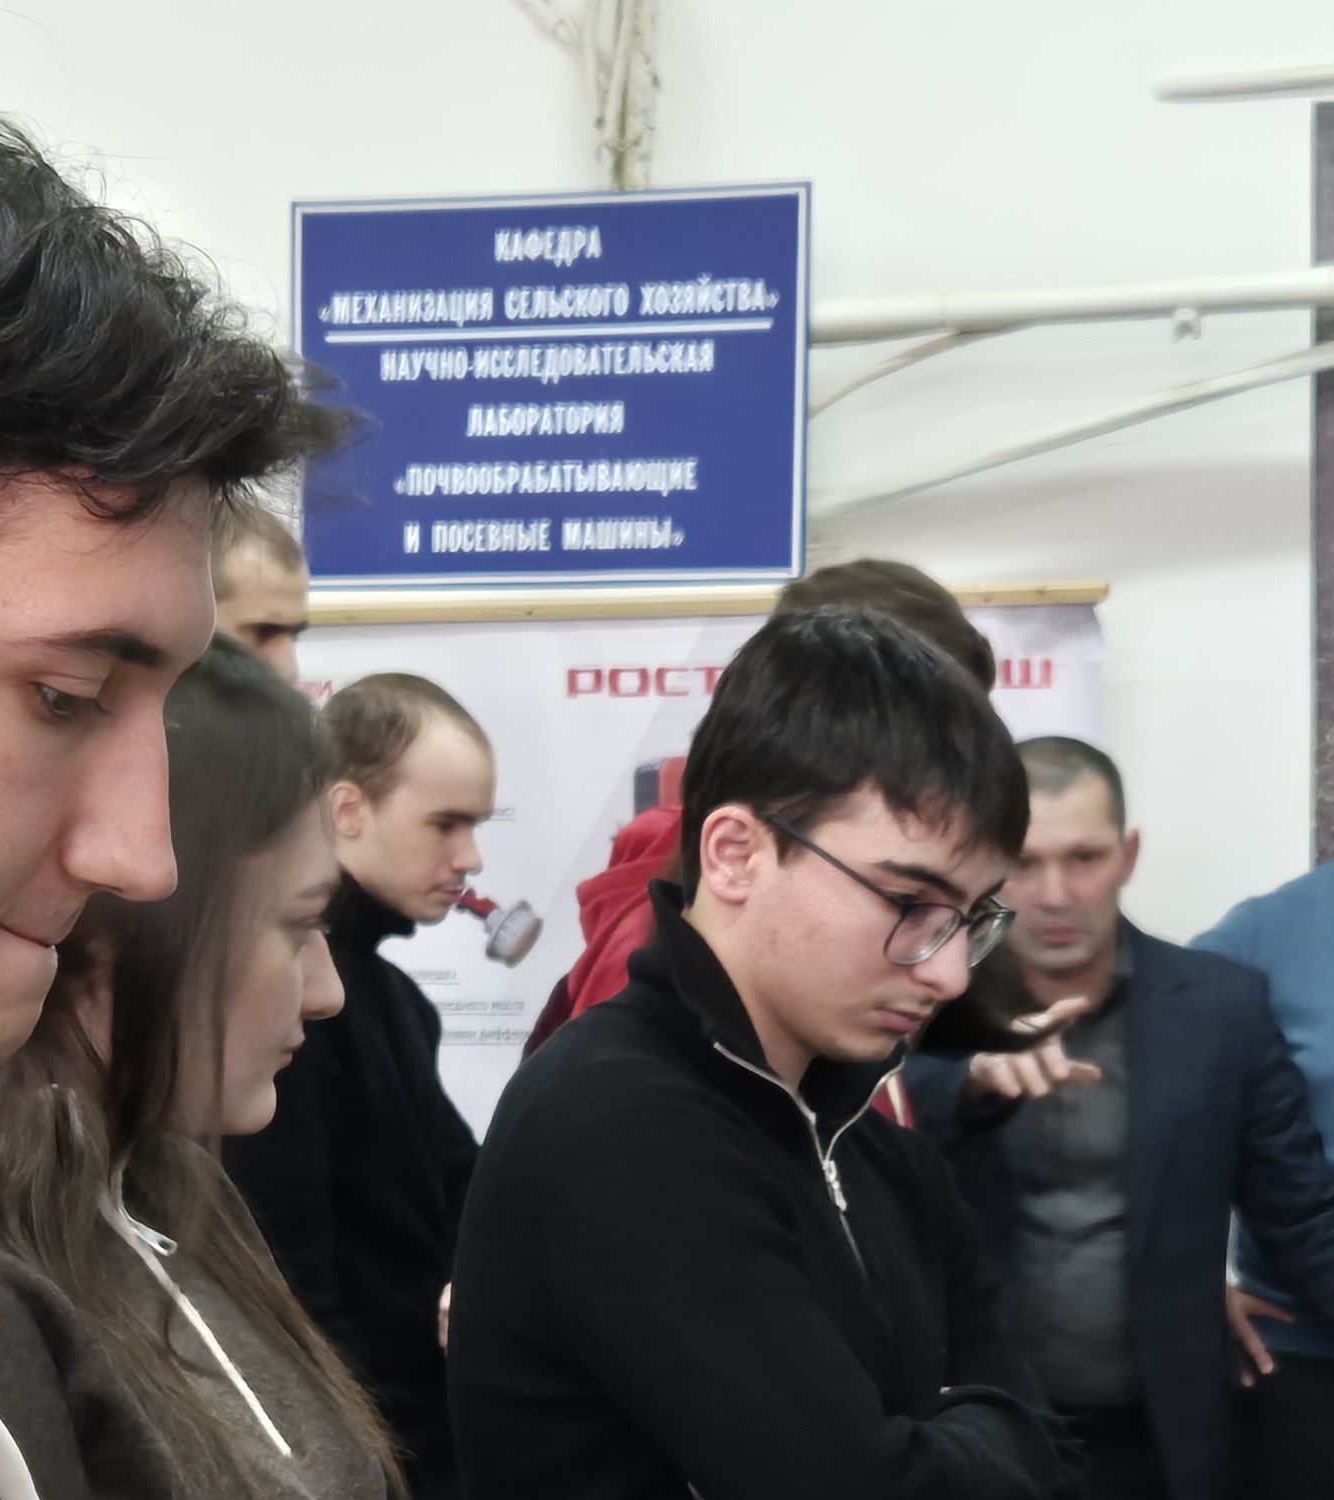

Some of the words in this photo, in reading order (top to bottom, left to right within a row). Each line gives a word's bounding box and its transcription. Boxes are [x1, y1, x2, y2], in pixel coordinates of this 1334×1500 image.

[494, 226, 602, 268] КАФЕДРА
[319, 287, 494, 328] «МЕХАНИЗАЦИЯ
[504, 282, 630, 320] СЕЛЬСКОГО
[639, 272, 780, 316] ХОЗЯЙСТВА»
[380, 340, 715, 385] НАУЧНО-ИССЛЕДОВАТЕЛЬСКАЯ
[467, 401, 624, 437] ЛАБОРАТОРИЯ
[404, 521, 420, 553] И
[431, 518, 551, 552] ПОСЕВНЫЕ
